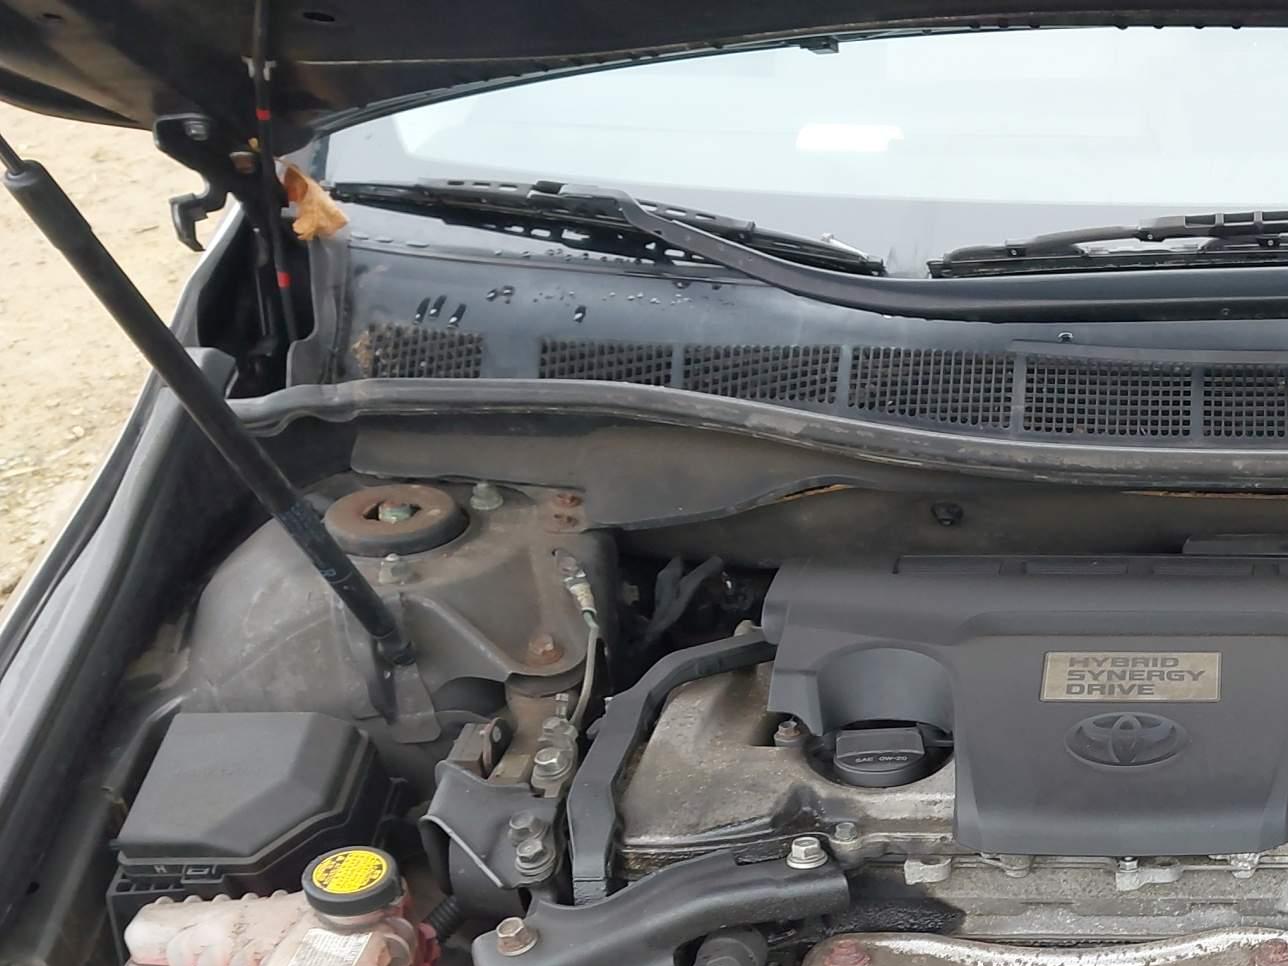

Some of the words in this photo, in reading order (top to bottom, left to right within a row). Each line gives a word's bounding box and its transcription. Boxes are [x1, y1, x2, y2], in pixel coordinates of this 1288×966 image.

[1069, 656, 1180, 668] HYBRID
[1067, 669, 1206, 682] SYNERGY
[1065, 683, 1156, 696] DRIVE
